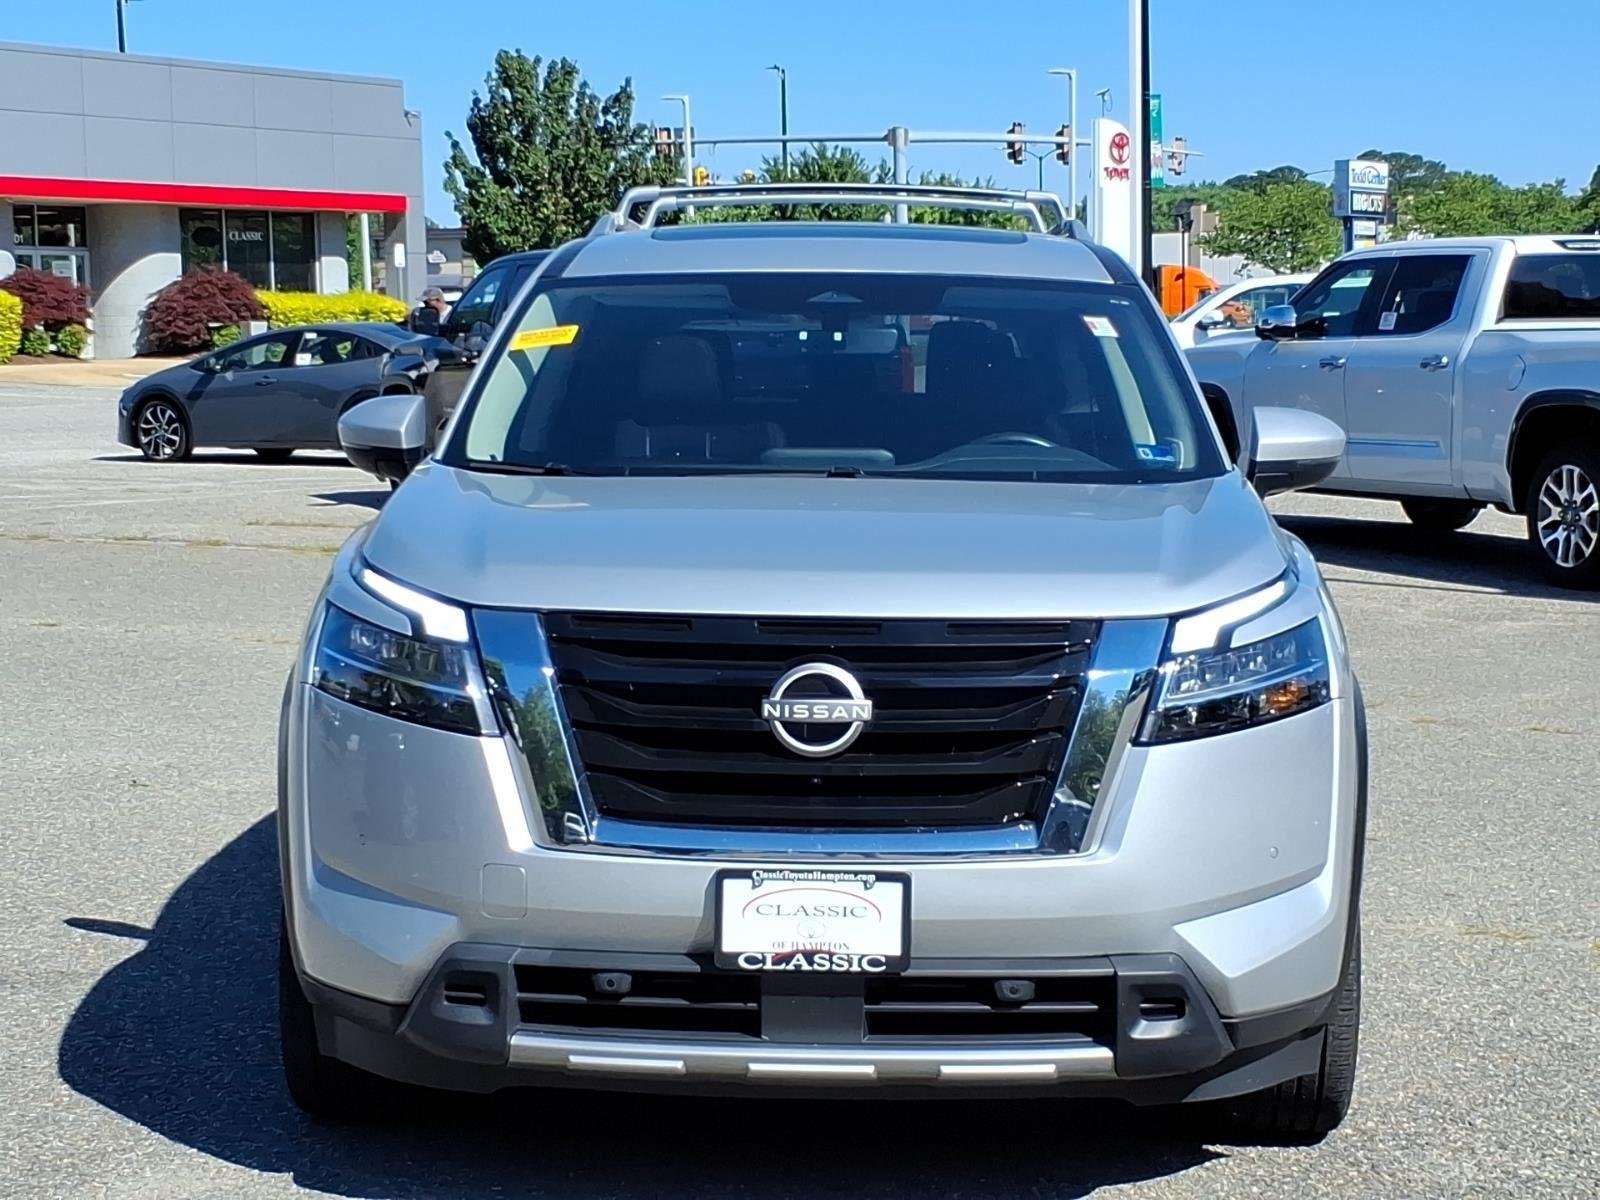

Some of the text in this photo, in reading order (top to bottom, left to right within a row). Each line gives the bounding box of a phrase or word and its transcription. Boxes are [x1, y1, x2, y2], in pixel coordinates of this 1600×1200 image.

[229, 231, 264, 241] CLASSIC
[763, 703, 869, 719] NISSAN
[751, 870, 876, 883] ClassicToyotaHampton.com
[756, 904, 867, 918] CLASSIC
[772, 941, 850, 951] OF HAMPTON
[738, 953, 886, 972] CLASSIC
